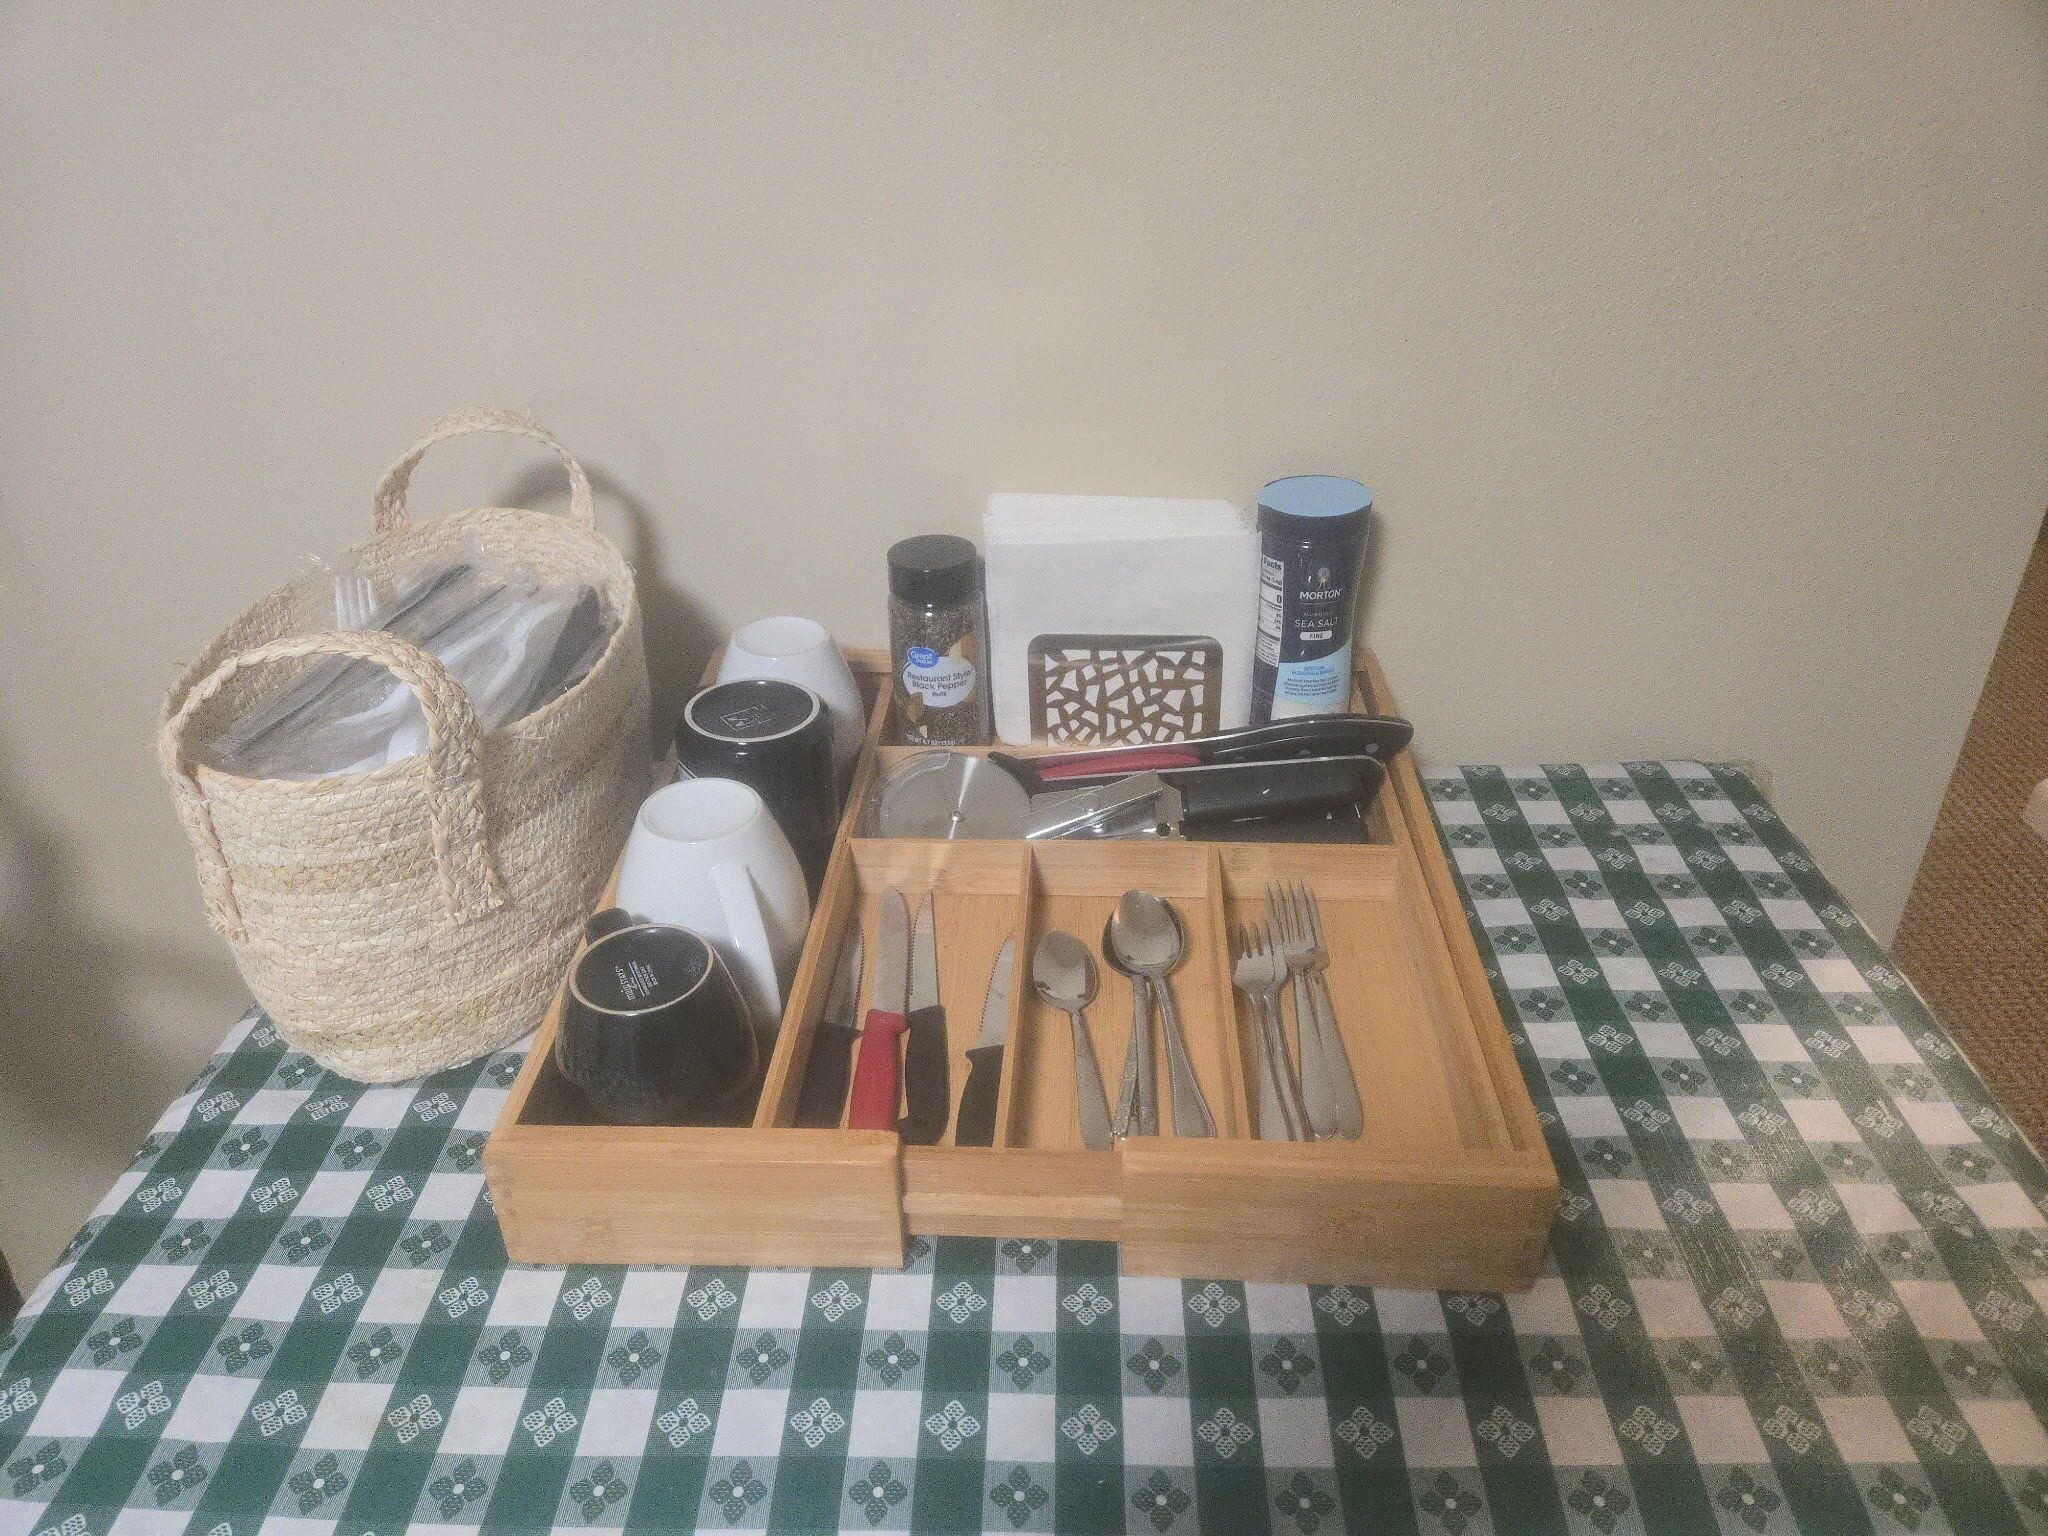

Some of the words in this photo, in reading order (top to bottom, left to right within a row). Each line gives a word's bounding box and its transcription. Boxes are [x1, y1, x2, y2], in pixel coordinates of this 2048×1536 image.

[1299, 589, 1341, 600] MORTON
[1294, 619, 1315, 628] SEA
[1317, 617, 1340, 628] SALT
[1309, 632, 1325, 640] FINE
[907, 671, 951, 682] Restaurant
[952, 670, 971, 681] Style
[911, 681, 935, 690] Black
[937, 680, 967, 691] Pepper
